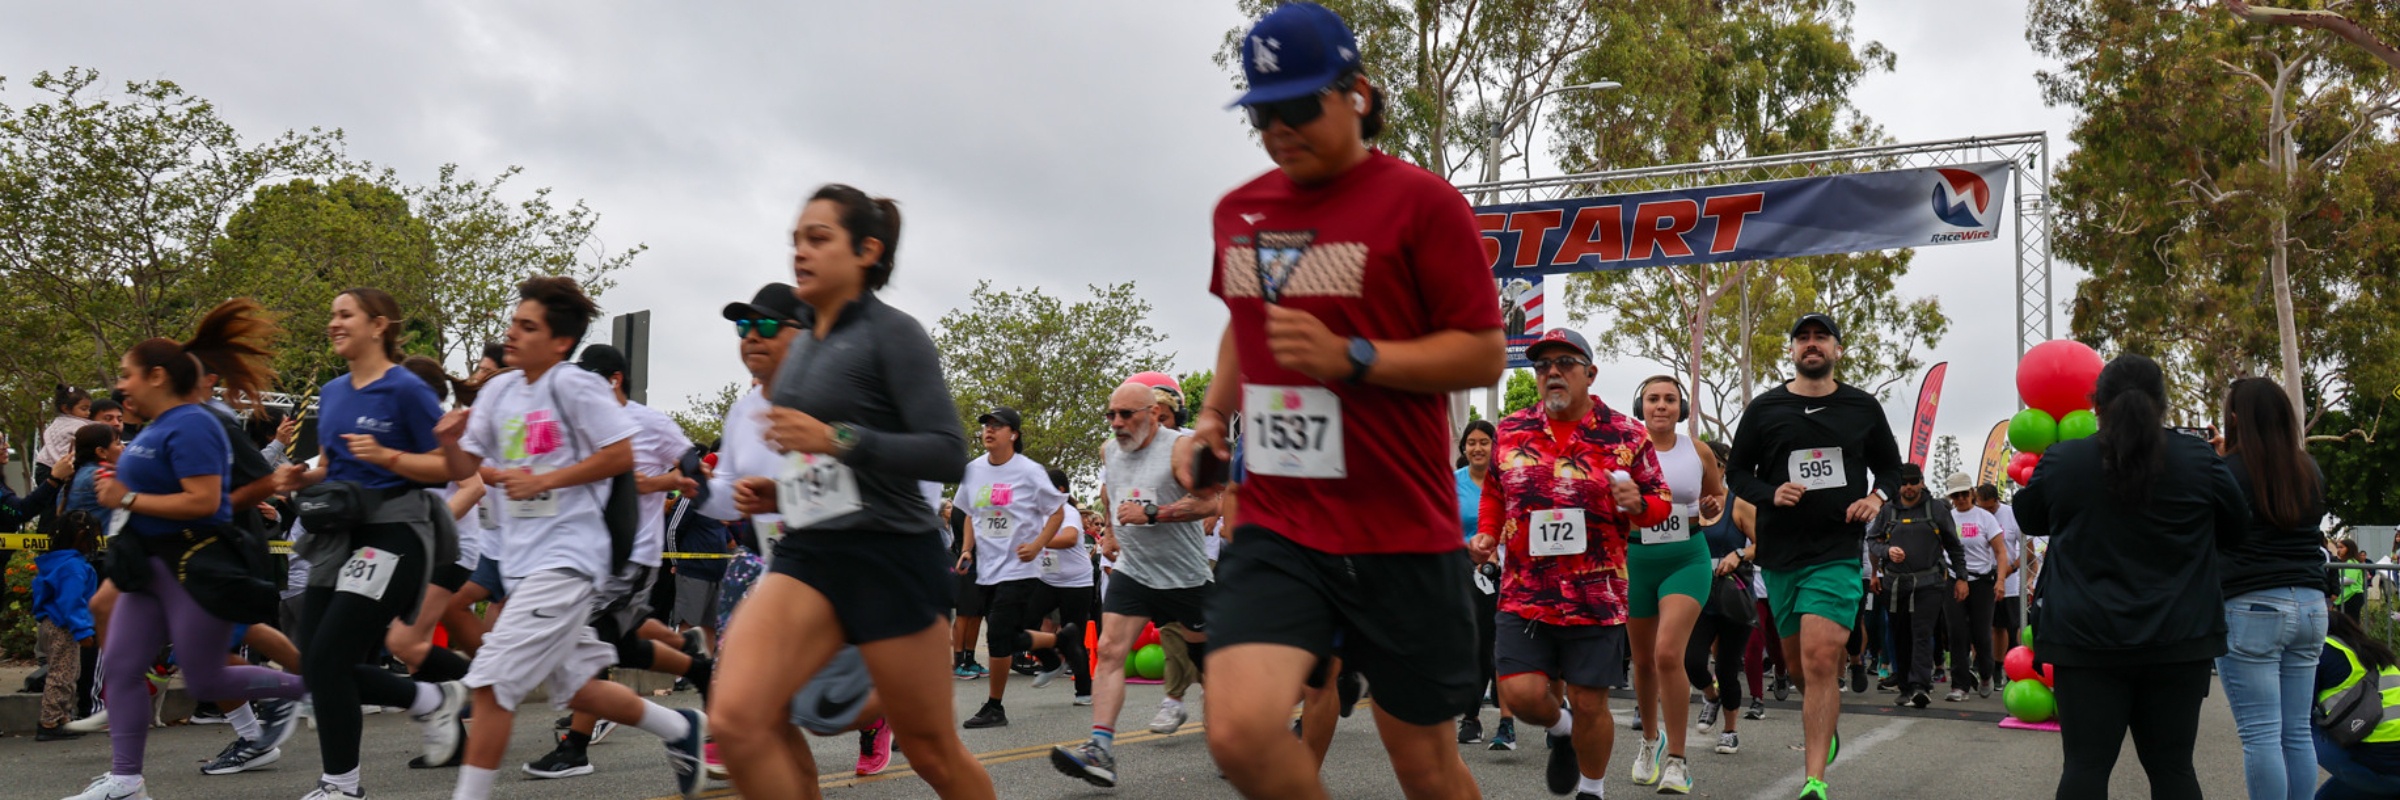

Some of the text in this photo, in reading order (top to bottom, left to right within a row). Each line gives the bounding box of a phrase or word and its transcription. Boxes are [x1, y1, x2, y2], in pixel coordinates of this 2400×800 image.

[1475, 192, 1765, 270] START
[1931, 230, 1990, 243] RaceWire
[1254, 413, 1328, 451] 1537
[1799, 459, 1833, 478] 595
[987, 517, 1007, 529] 762
[1539, 522, 1574, 542] 172
[344, 559, 377, 581] 581
